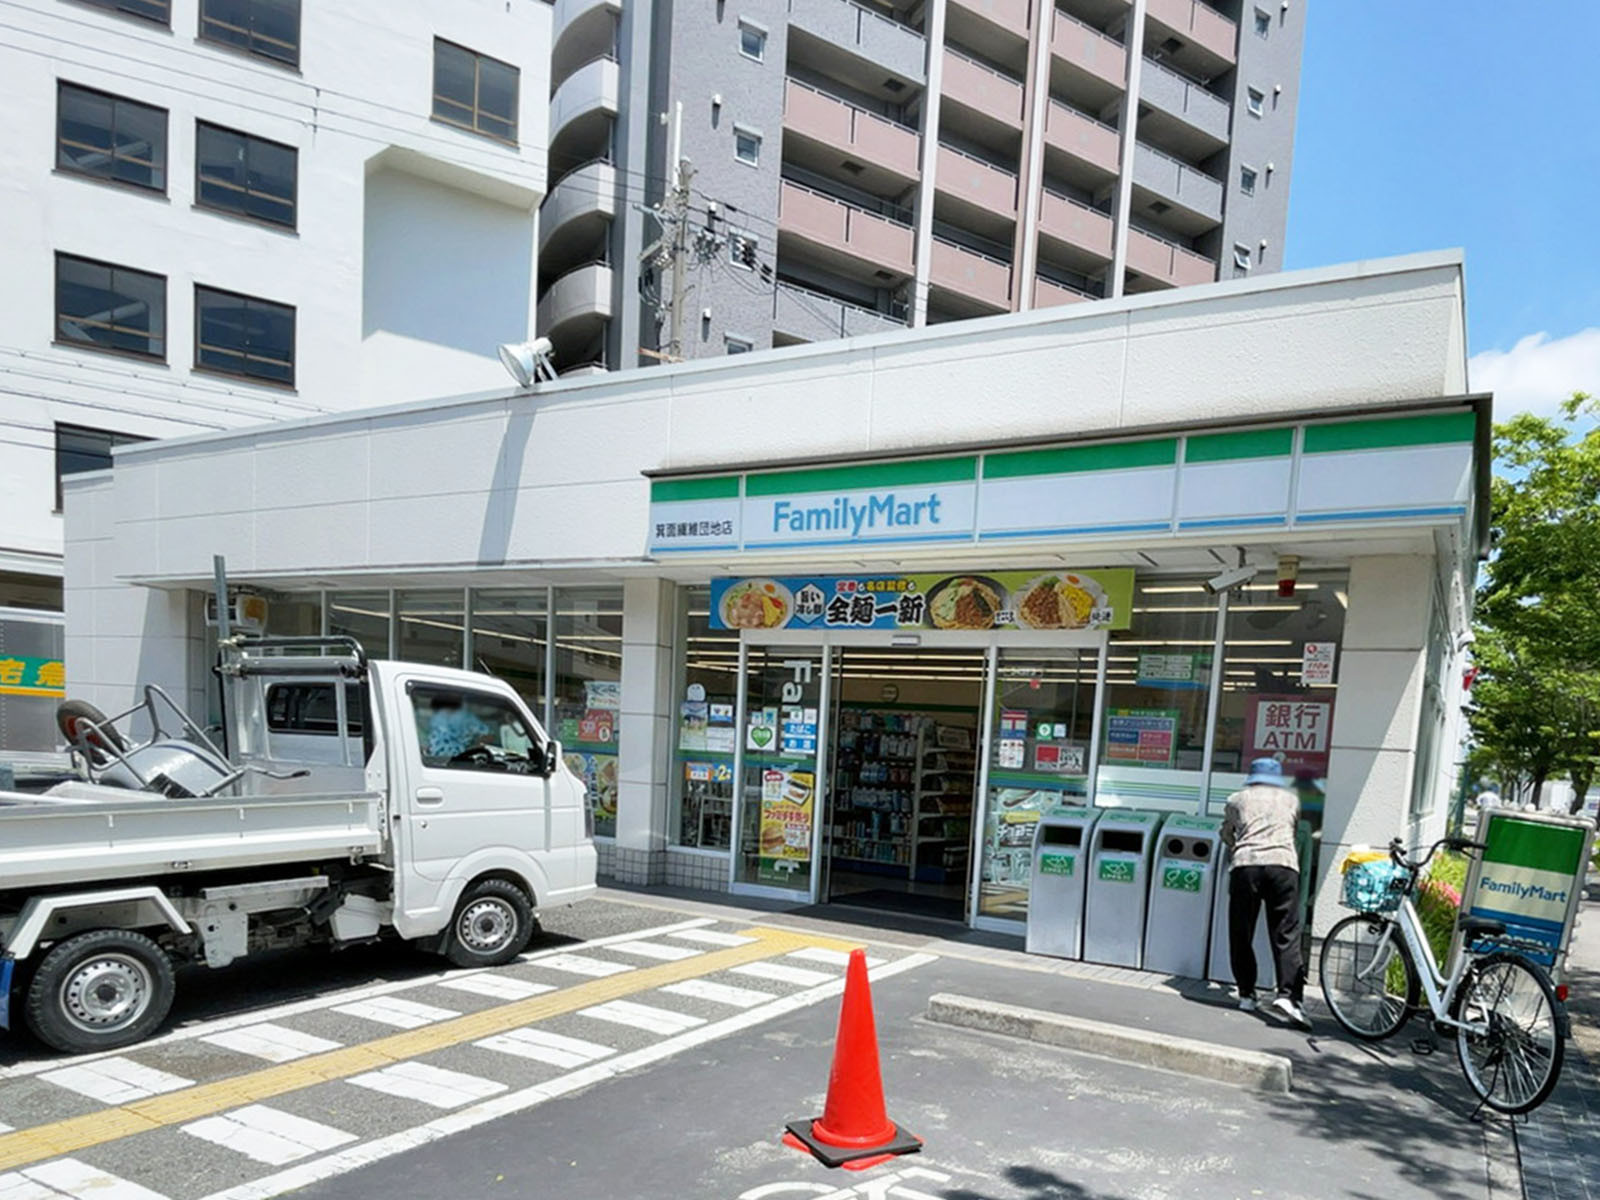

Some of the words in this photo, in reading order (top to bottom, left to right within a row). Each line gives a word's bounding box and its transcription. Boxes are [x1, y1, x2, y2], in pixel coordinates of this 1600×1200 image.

[773, 493, 941, 536] FamilyMart
[655, 520, 733, 538] 箕面繊維団地店
[1265, 703, 1321, 729] 銀行
[1262, 731, 1317, 750] ATM
[1480, 877, 1566, 902] FamilyMart
